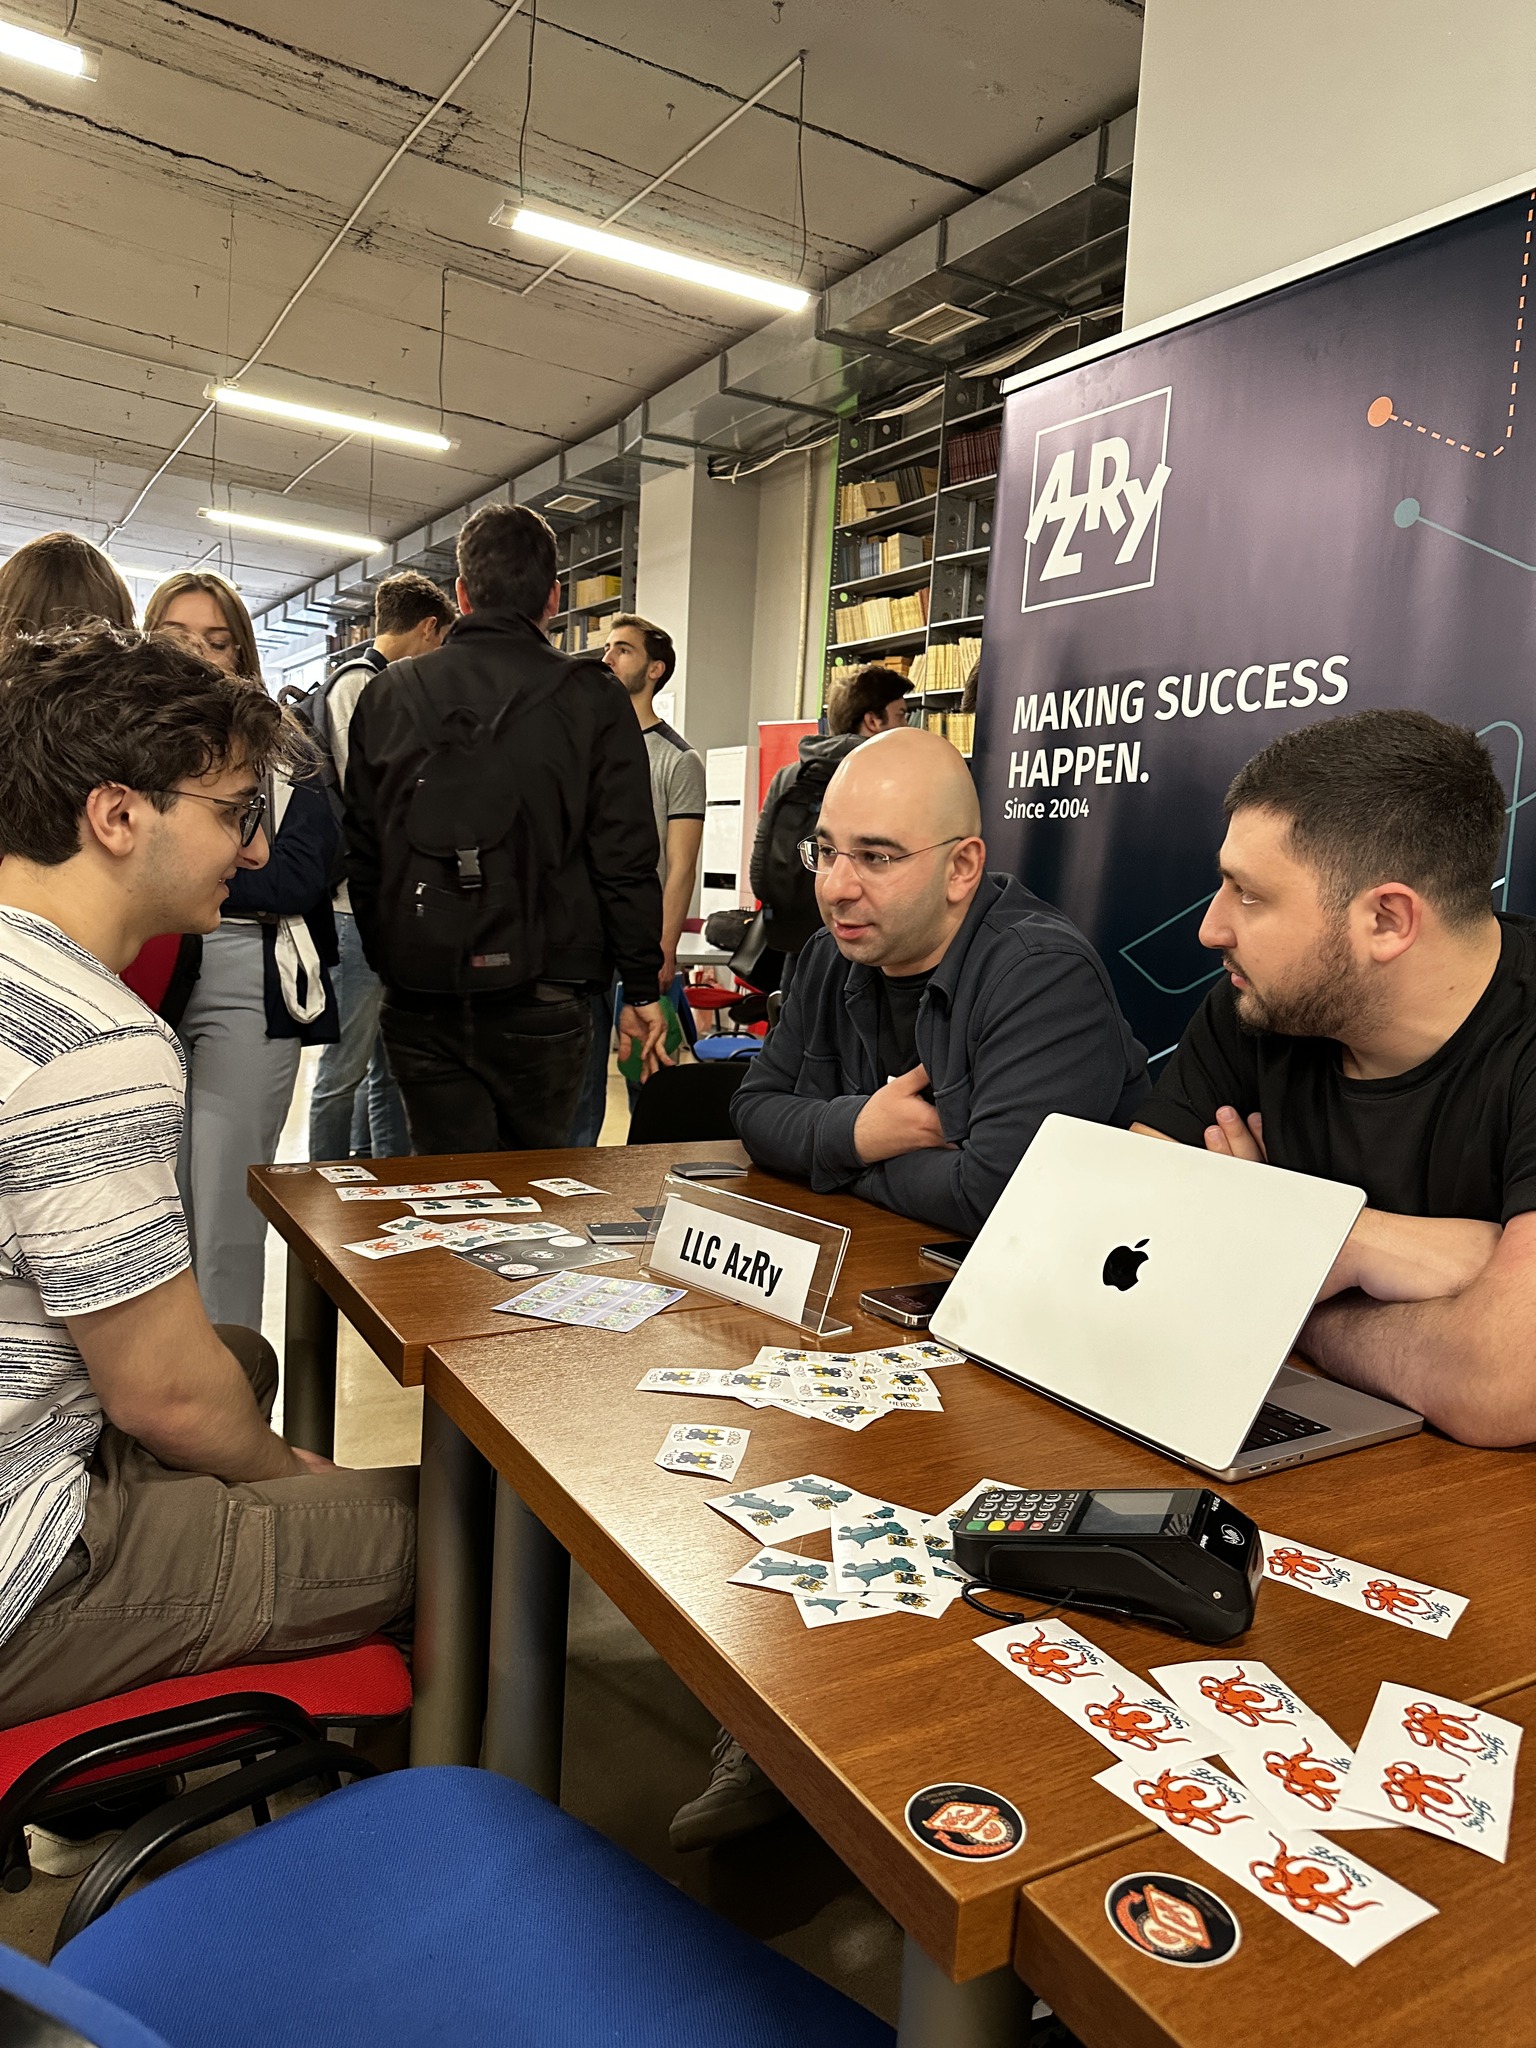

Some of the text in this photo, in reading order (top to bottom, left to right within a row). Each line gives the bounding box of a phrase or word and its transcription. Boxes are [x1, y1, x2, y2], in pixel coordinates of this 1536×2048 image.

[1012, 655, 1350, 735] MAKING SUCCESS
[1007, 741, 1150, 789] HAPPEN.
[1003, 797, 1090, 820] Since 2004
[679, 1227, 783, 1297] LLC AzRy
[888, 1400, 922, 1408] HEROES
[896, 1385, 929, 1393] HEROES
